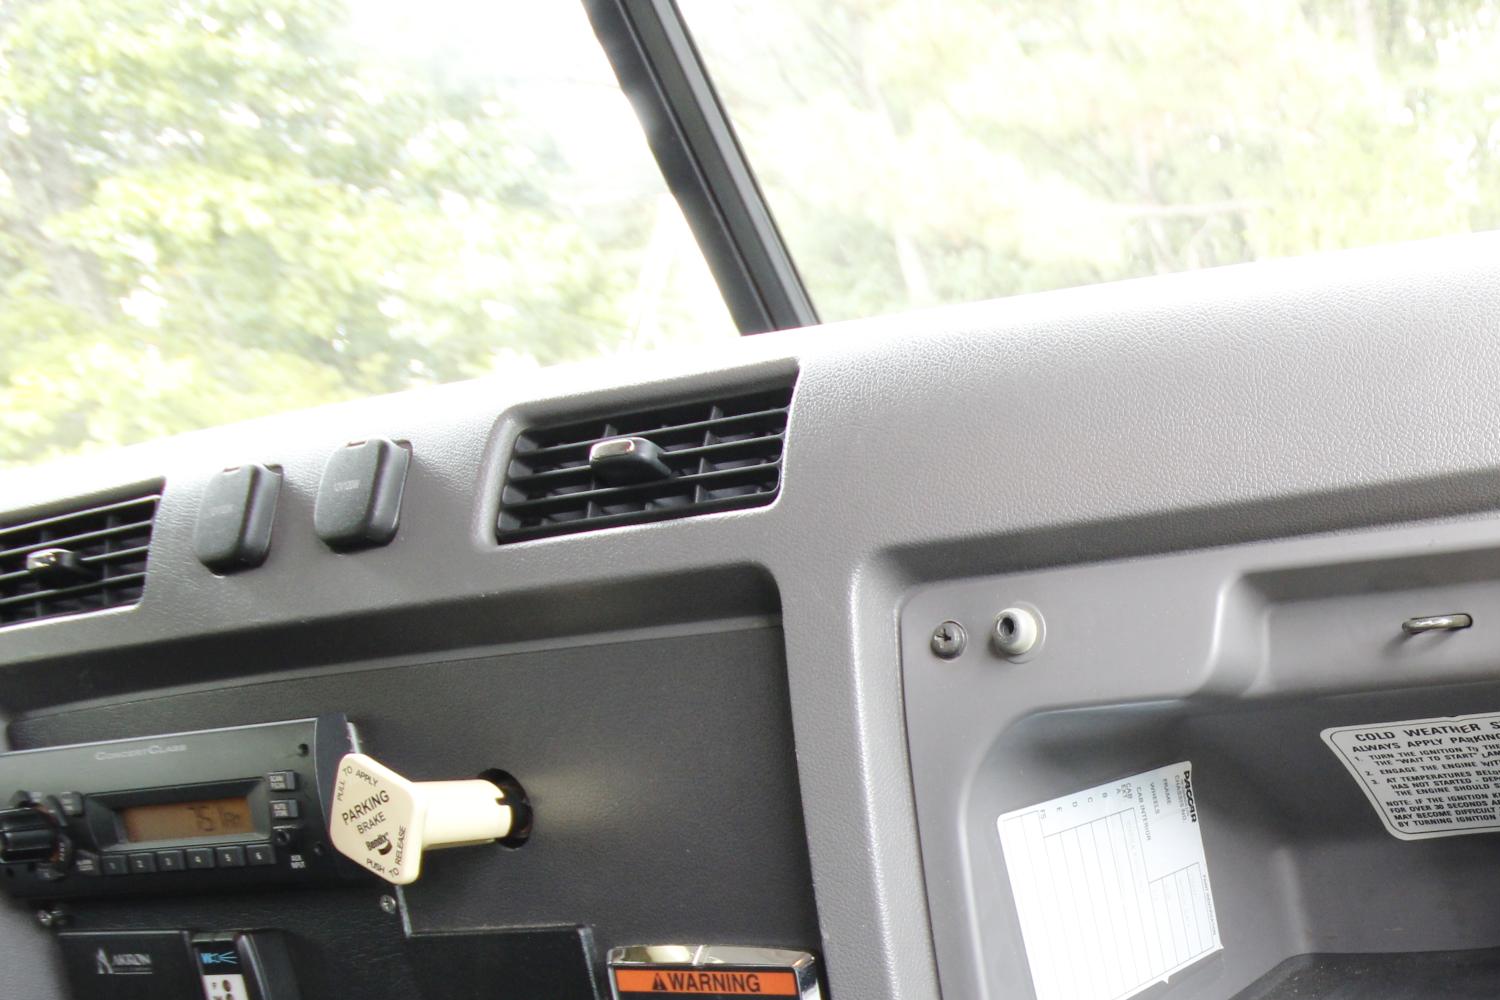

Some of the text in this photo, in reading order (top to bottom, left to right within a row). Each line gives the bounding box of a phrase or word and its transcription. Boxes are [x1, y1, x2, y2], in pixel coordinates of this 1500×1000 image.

[1355, 731, 1395, 741] COLD
[1403, 724, 1480, 737] WEATHER
[1352, 742, 1400, 752] ALWAYS
[1407, 739, 1443, 748] APPLY
[1420, 748, 1463, 756] IGNITION
[343, 766, 353, 776] TO
[356, 770, 378, 787] APPLY
[1380, 767, 1417, 775] ENGAGE
[1405, 772, 1472, 782] TEMPERATURES
[1433, 778, 1472, 786] STARTED
[1453, 784, 1490, 792] SHOULD
[1150, 782, 1160, 814] WHEELS
[1184, 770, 1197, 823] PACCAR
[342, 790, 390, 825] PARKING
[1447, 801, 1488, 809] SECONDS
[1455, 807, 1495, 815] DIFFICULT
[357, 811, 386, 834] BRAKE
[1140, 805, 1151, 840] INTERIOR
[1414, 818, 1452, 826] TURNING
[1456, 814, 1496, 822] IGNITION
[366, 825, 406, 877] PUSH TO RELEASE
[670, 973, 761, 992] WARNING
